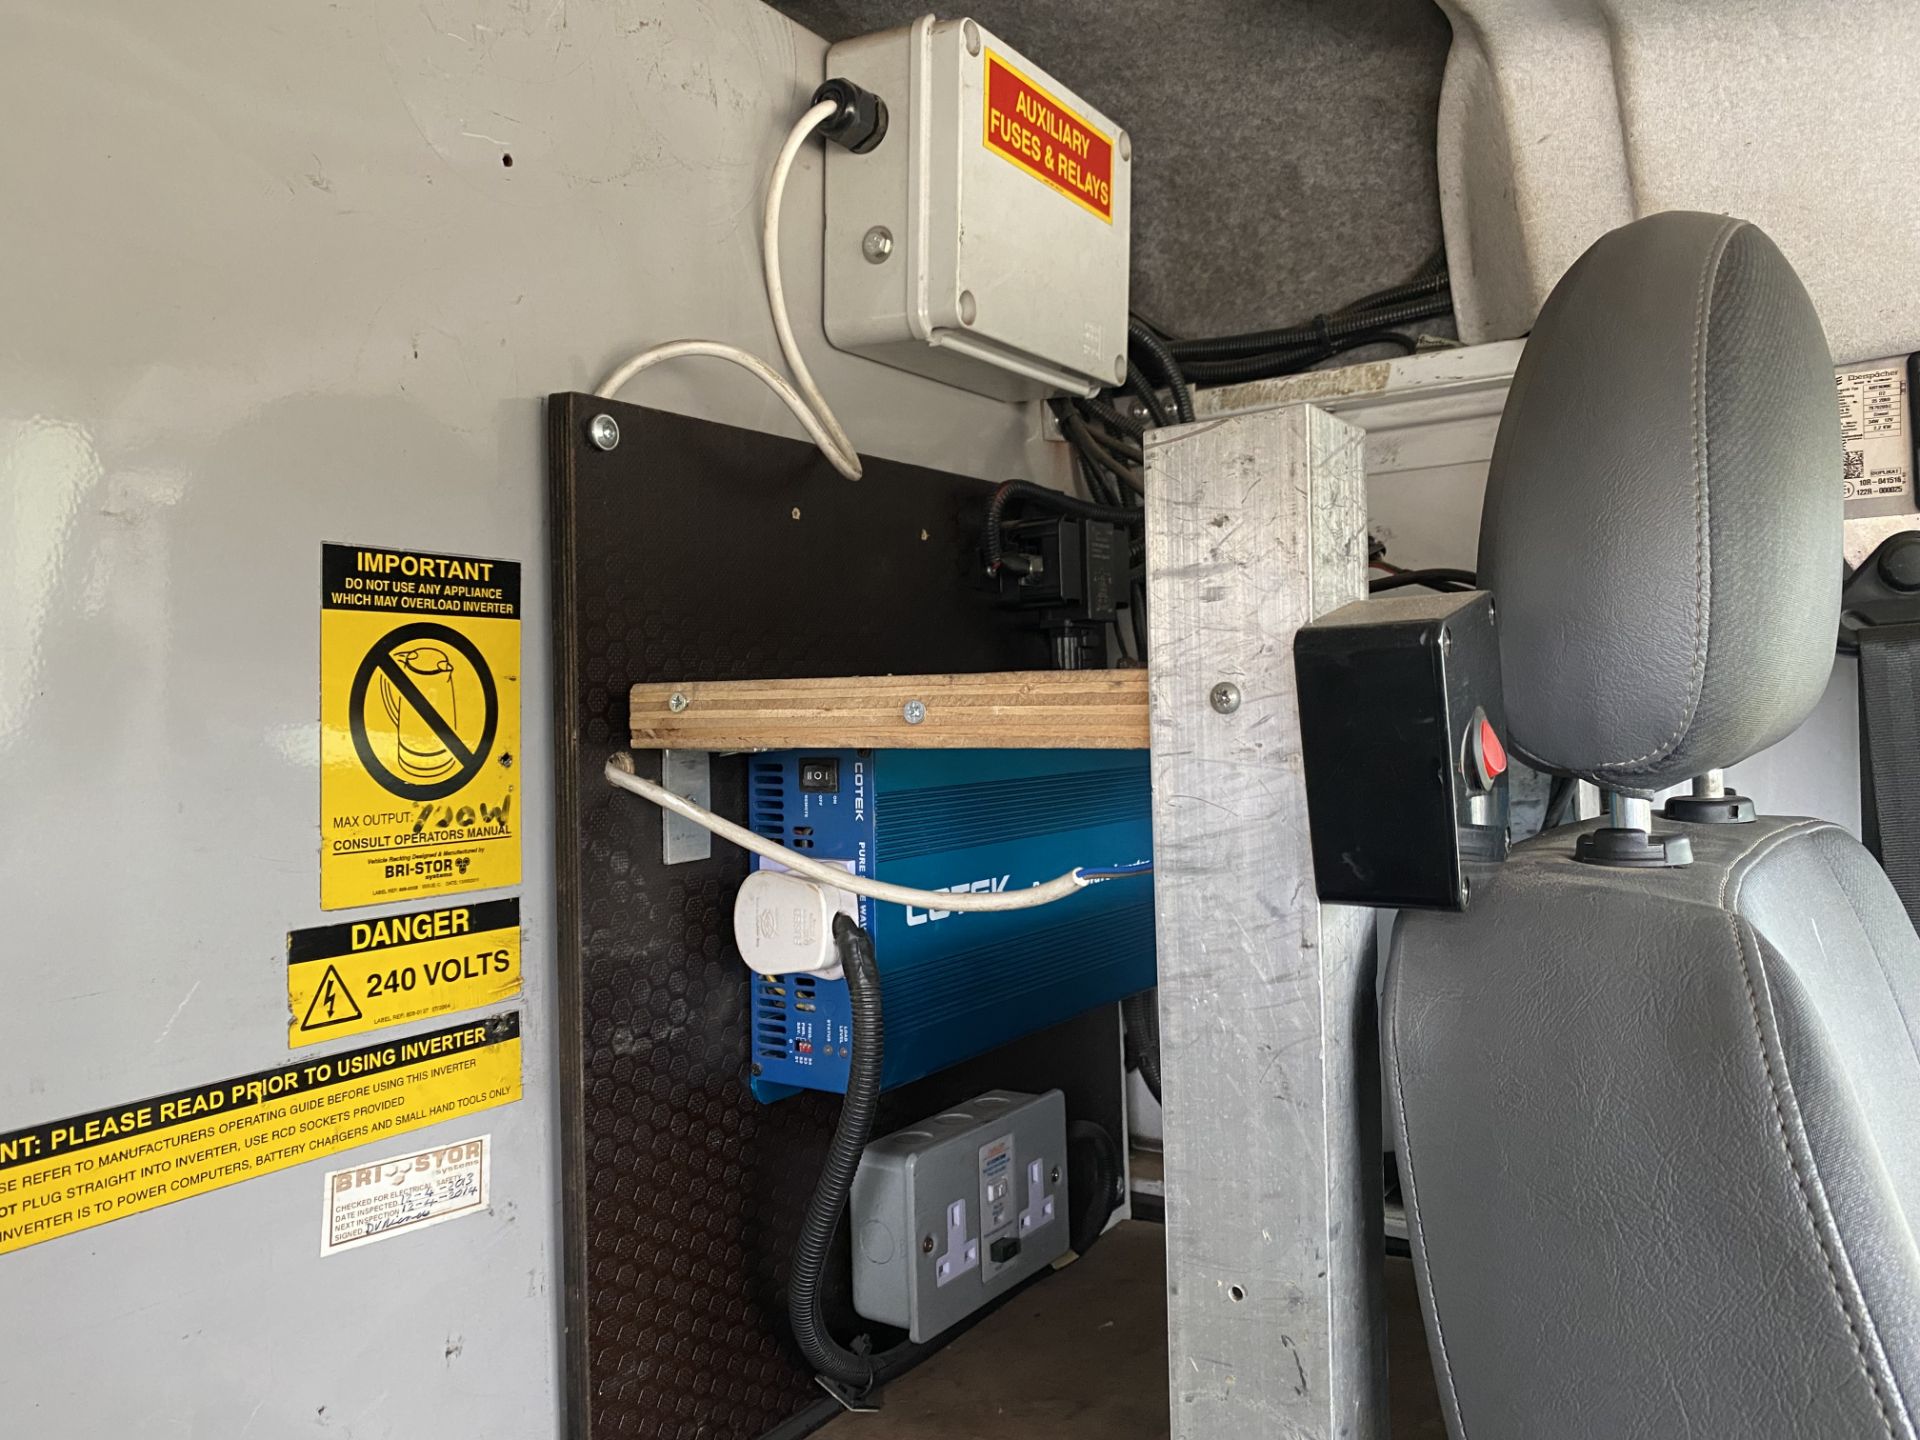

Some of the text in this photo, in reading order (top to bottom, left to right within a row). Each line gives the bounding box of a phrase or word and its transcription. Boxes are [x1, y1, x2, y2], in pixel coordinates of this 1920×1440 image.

[1016, 91, 1090, 159] AUXILIARY
[991, 107, 1109, 206] FUSES & RELAYS
[357, 551, 493, 581] IMPORTANT
[331, 592, 514, 615] WHICH MAY OVERLOAD INVERTER
[345, 578, 502, 600] DO NOT USE ANY APPLIANCE
[855, 763, 864, 821] COTEK
[333, 811, 414, 829] MAX OUTPUT:
[333, 825, 511, 851] CONSULT OPERATORS MANUAL
[385, 859, 452, 878] BRI-STOR
[351, 908, 469, 951] DANGER
[367, 949, 510, 998] 240 VOLTS
[51, 1107, 152, 1150] PLEASE
[160, 1091, 224, 1122] READ
[232, 1072, 298, 1104] PRIOR
[304, 1064, 331, 1085] TO
[337, 1049, 396, 1077] USING
[401, 1026, 486, 1062] INVERTER
[22, 1166, 72, 1188] REFER
[74, 1160, 94, 1172] TO
[98, 1127, 215, 1167] MANUFACTURERS
[219, 1107, 286, 1134] OPERATING
[290, 1098, 324, 1115] GUIDE
[327, 1086, 370, 1106] BEFORE
[373, 1077, 404, 1092] USING
[406, 1071, 428, 1084] THIS
[430, 1058, 477, 1077] INVERTER
[0, 1086, 511, 1242] INVERTER IS TO POWER COMPUTERS, BATTERY CHARGERS AND SMALL HAND TOOLS ONLY
[23, 1191, 61, 1212] PLUG
[66, 1170, 136, 1199] STRAIGHT
[140, 1161, 171, 1178] INTO
[176, 1141, 241, 1168] INVERTER,
[244, 1134, 268, 1149] USE
[272, 1127, 296, 1141] RCD
[300, 1111, 350, 1135] SOCKETS
[354, 1096, 405, 1118] PROVIDED
[335, 1143, 480, 1193] BRI STOR
[335, 1175, 462, 1213] CHECKED FOR ELECTRICAL SAFETY
[335, 1212, 356, 1223] DATE
[357, 1201, 398, 1217] INSPECTED
[334, 1229, 363, 1242] SIGNED
[335, 1221, 355, 1232] NEXT
[356, 1209, 399, 1227] INSPECTION
